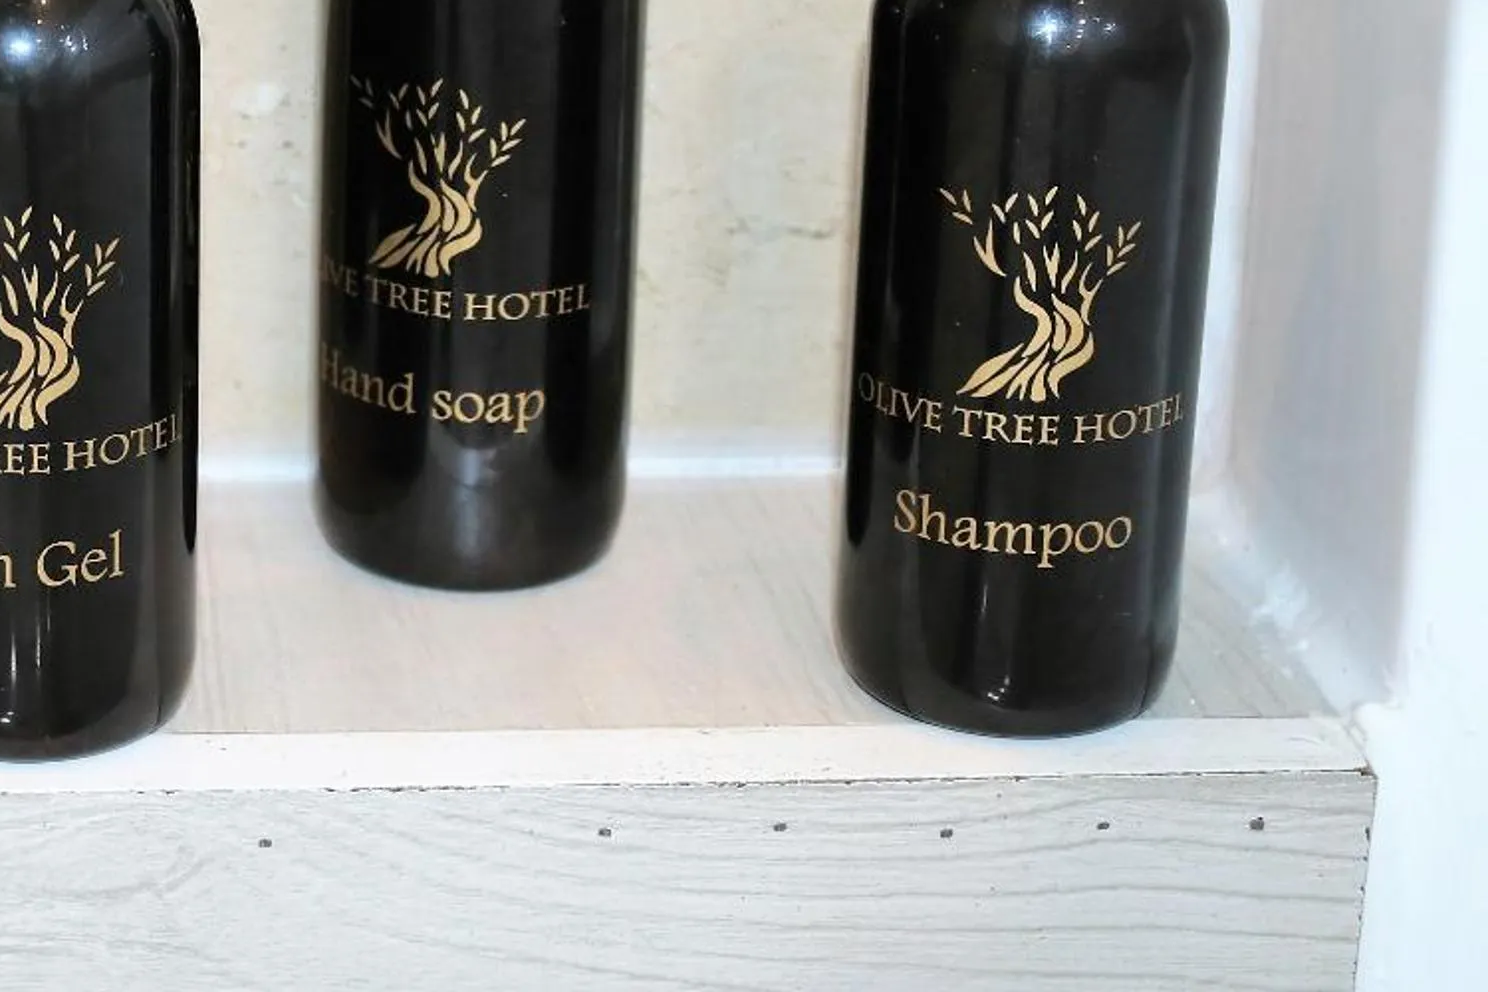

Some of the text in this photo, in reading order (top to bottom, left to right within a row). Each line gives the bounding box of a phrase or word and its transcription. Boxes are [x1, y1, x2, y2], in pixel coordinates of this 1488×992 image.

[365, 274, 453, 320] TREE
[463, 282, 592, 321] HOTEL
[320, 342, 546, 435] Hand soap
[858, 371, 1185, 447] OLIVE TREE HOTEL
[63, 412, 182, 472] HOTEL
[36, 528, 126, 588] Gel
[893, 488, 1134, 570] Shampoo
